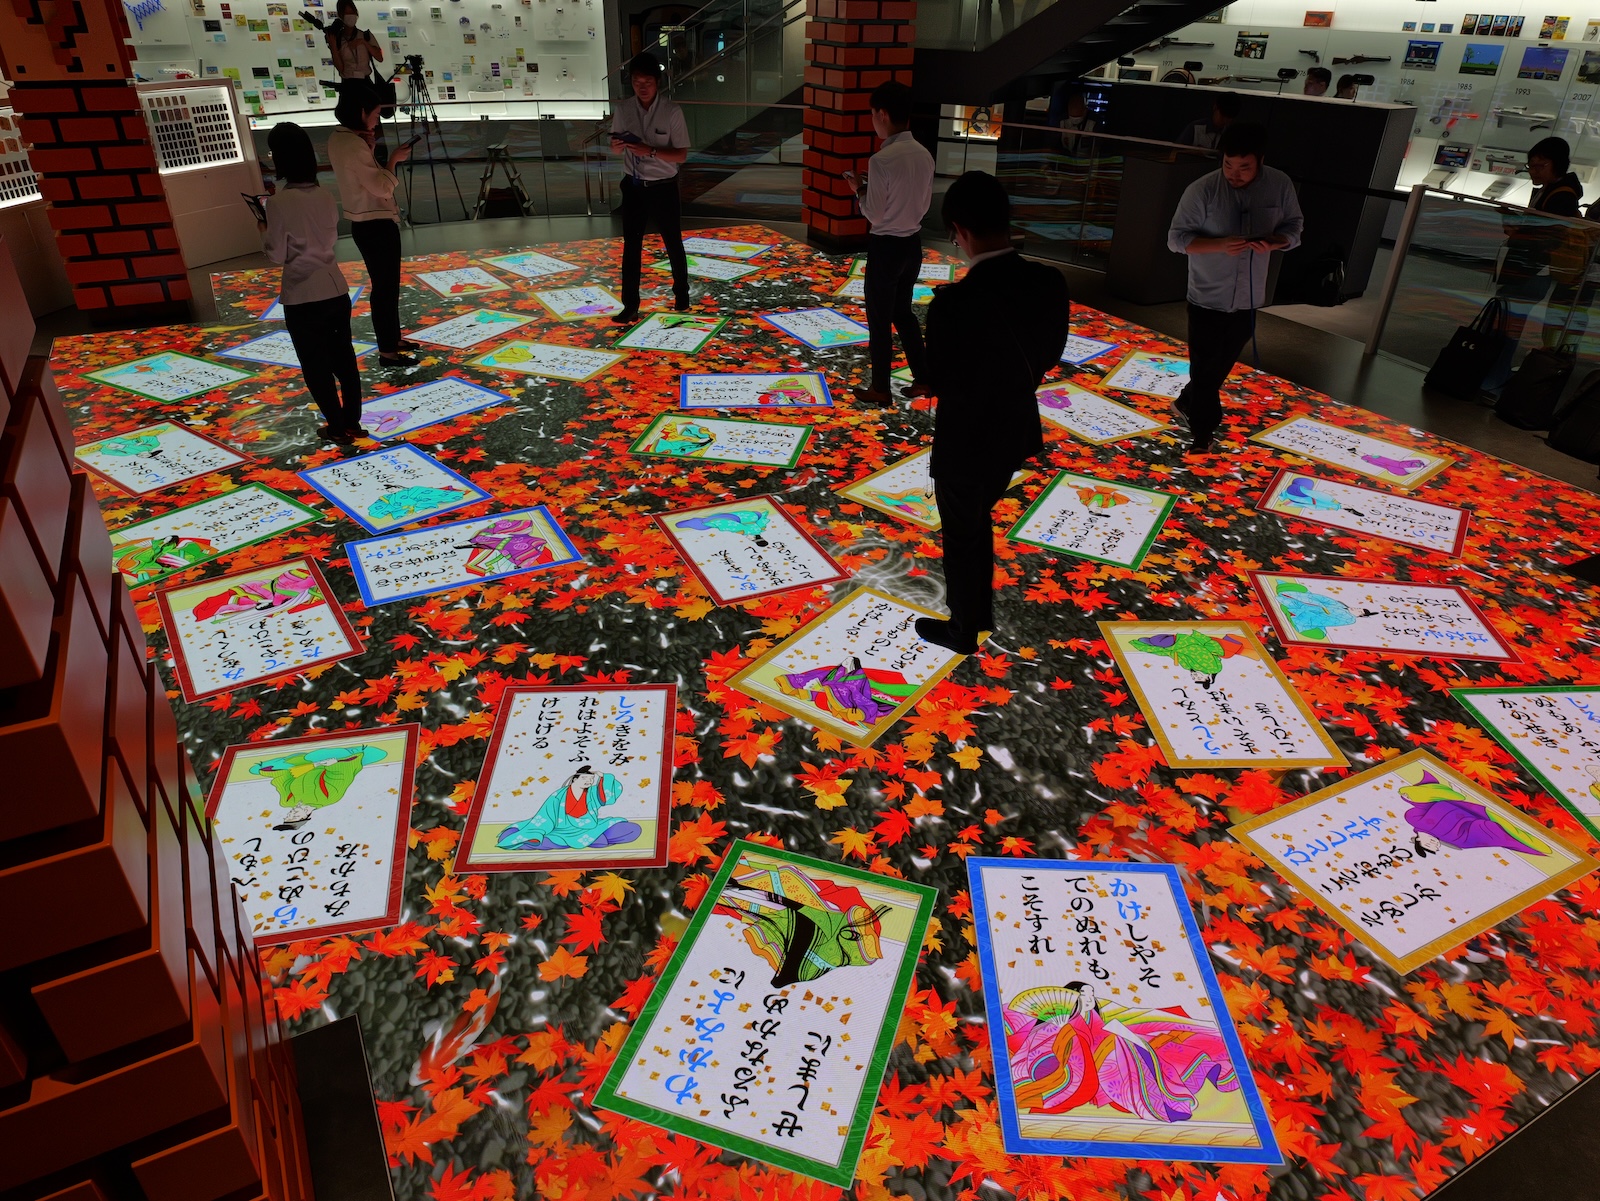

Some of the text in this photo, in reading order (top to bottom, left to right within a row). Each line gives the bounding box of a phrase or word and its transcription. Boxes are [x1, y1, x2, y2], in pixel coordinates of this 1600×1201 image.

[1400, 77, 1415, 86] 1984
[1457, 82, 1473, 91] 1985
[1515, 87, 1531, 96] 1993
[1573, 93, 1592, 102] 2007
[365, 536, 454, 560] よにあふさ
[371, 550, 456, 573] かのせきは
[711, 549, 758, 592] むへやまか
[744, 546, 784, 586] せをあらし
[766, 541, 813, 579] といふらむ
[376, 567, 447, 587] ゆるさし
[1387, 595, 1459, 607] ほひける
[290, 620, 323, 659] たるへき
[847, 603, 892, 636] かはしる
[865, 613, 917, 656] しきものと
[1380, 610, 1473, 624] しのかにに
[1385, 625, 1488, 642] はなそむか
[213, 631, 246, 681] みをつくし
[248, 618, 287, 671] てやこひわ
[891, 638, 929, 671] にひさ
[532, 697, 560, 749] けにける
[568, 696, 598, 762] れはよそふ
[609, 694, 636, 765] しろきをみ
[1172, 687, 1221, 756] うしとみし
[1206, 691, 1256, 755] よそいまは
[1254, 702, 1295, 753] こひしき
[1497, 698, 1558, 748] かのせき
[231, 838, 262, 889] へもし
[1283, 815, 1383, 867] ひとしれす
[272, 831, 315, 925] らぬこひの
[324, 843, 358, 917] みちかな
[1321, 845, 1413, 893] こそおもひ
[1021, 876, 1055, 955] こそすれ
[1065, 877, 1110, 980] てのぬれも
[1361, 883, 1441, 927] そめしか
[1109, 877, 1160, 988] かけしやそ
[664, 967, 745, 1106] わかみよに
[721, 994, 789, 1119] ふるなかめ
[772, 1031, 832, 1138] せしまに
